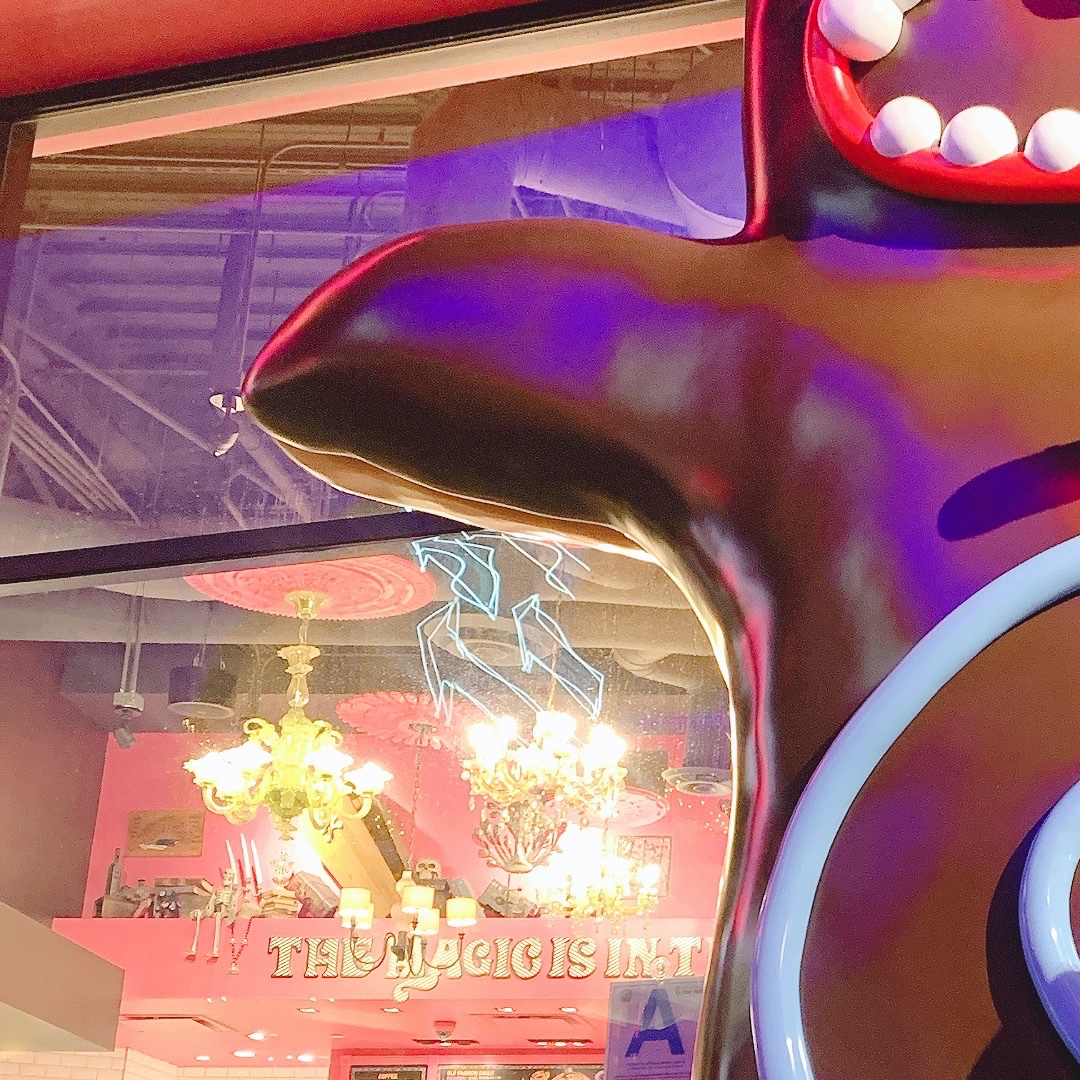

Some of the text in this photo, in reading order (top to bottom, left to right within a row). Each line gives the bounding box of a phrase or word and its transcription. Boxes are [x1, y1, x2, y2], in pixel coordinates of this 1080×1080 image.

[267, 936, 374, 979] THE
[547, 936, 597, 979] IS
[604, 936, 662, 979] IN
[669, 936, 713, 977] T
[624, 988, 685, 1057] A
